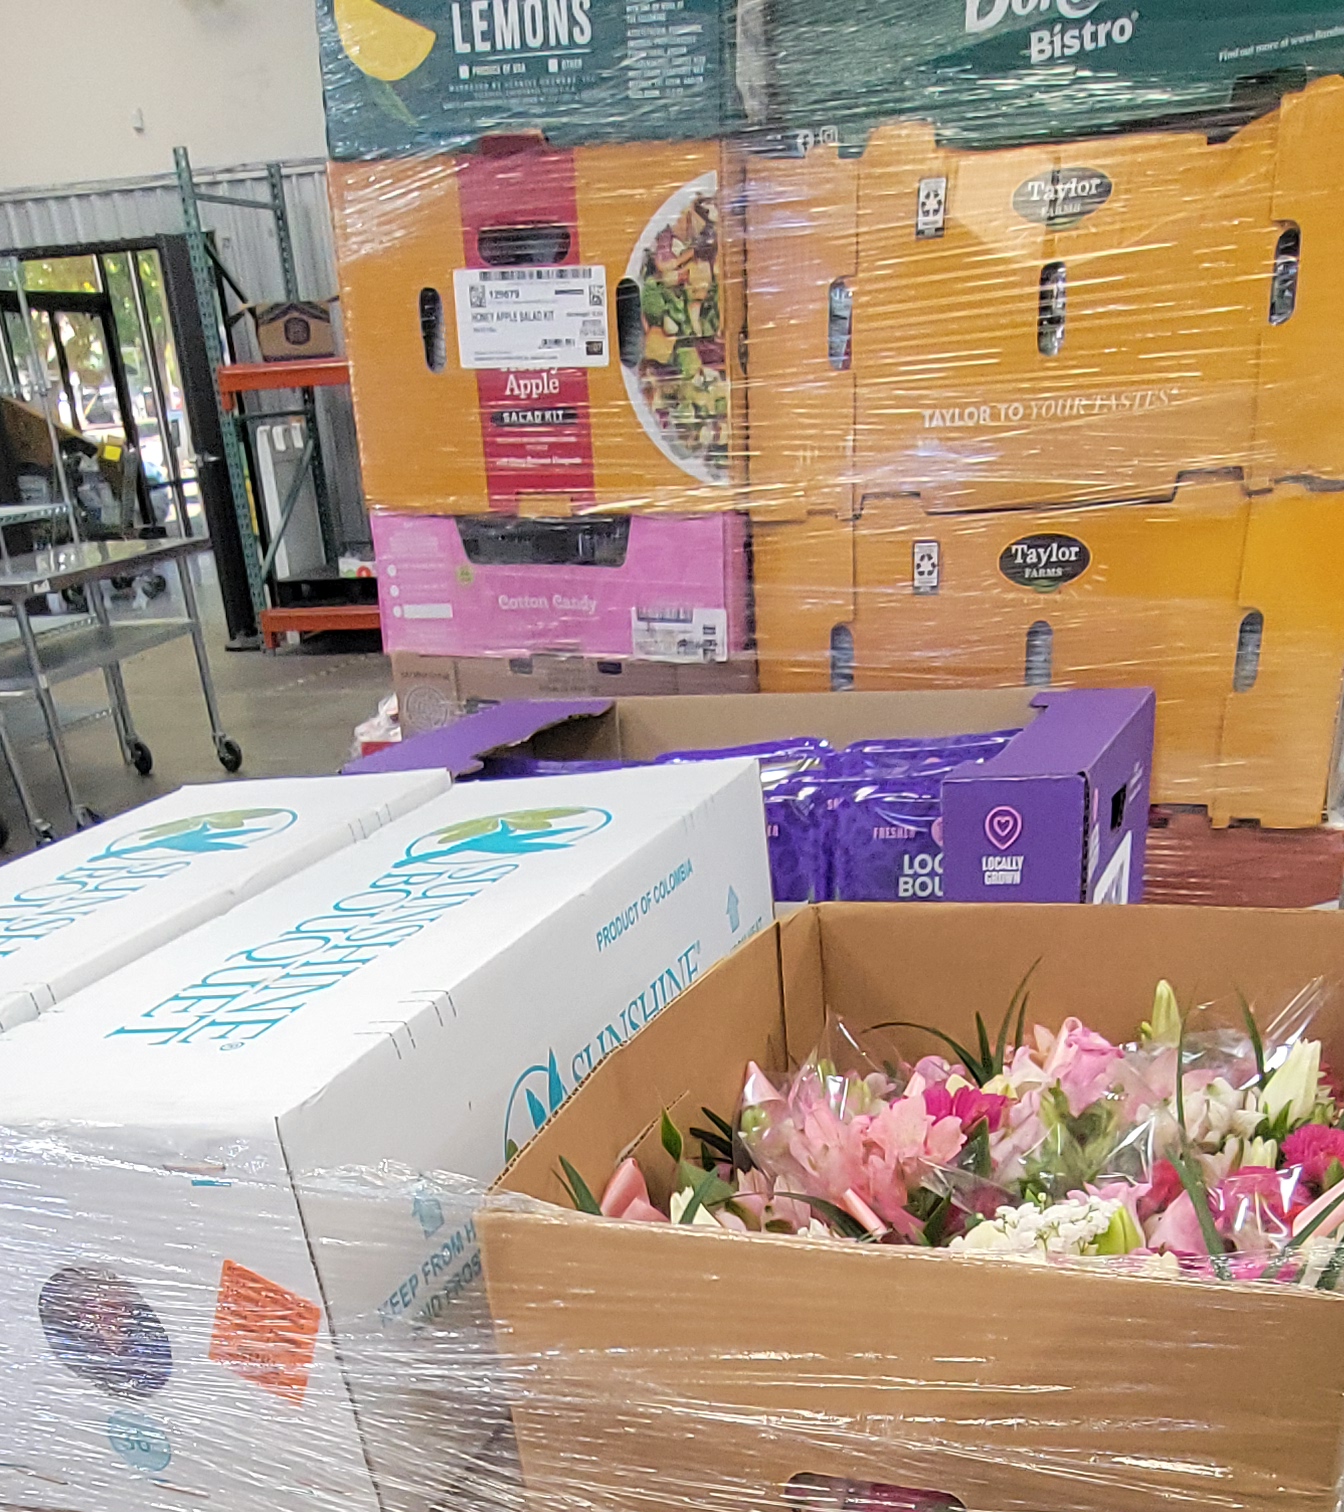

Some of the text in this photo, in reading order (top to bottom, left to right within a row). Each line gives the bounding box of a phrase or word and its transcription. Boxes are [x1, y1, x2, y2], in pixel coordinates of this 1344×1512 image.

[451, 0, 592, 54] LEMONS
[1030, 18, 1134, 64] Bistro
[1027, 177, 1103, 203] Taylor
[504, 371, 560, 399] Apple
[921, 405, 992, 428] TAYLOR
[1000, 402, 1025, 423] TO
[1030, 395, 1087, 421] YOUR
[1011, 543, 1080, 567] Taylor
[1024, 567, 1063, 579] FARMS
[498, 593, 598, 615] Cotton Candy
[981, 855, 1025, 873] LOCALLY
[984, 870, 1021, 886] GROWN
[595, 857, 694, 953] PRODUCT OF COLOMBIA
[103, 871, 446, 1047] BOUQUET
[176, 863, 520, 1044] SUNSHINE
[421, 1230, 465, 1286] FROM
